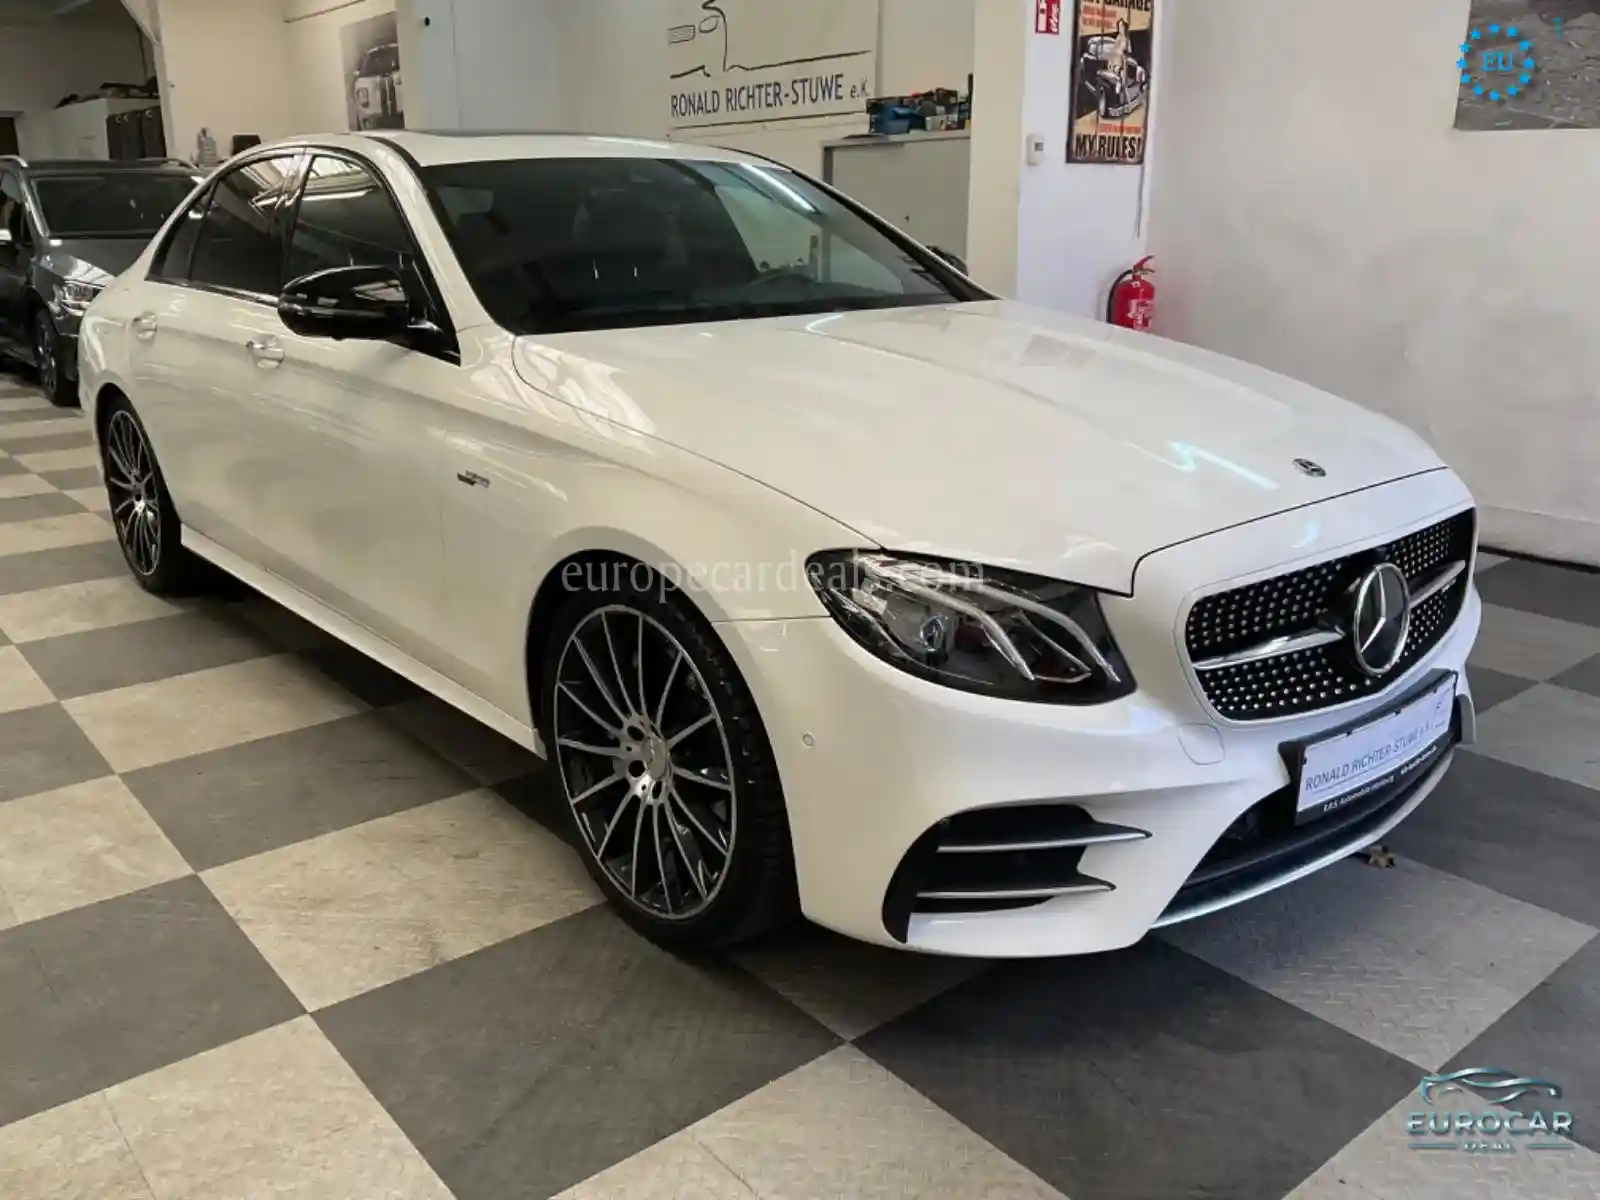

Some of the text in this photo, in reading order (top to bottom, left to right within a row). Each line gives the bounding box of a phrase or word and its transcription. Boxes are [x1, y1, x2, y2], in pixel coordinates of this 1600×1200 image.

[670, 90, 720, 118] RONALD
[725, 73, 844, 113] RICHTER-STUWE
[1075, 133, 1142, 160] MY RULES!
[1305, 764, 1350, 791] RONALD
